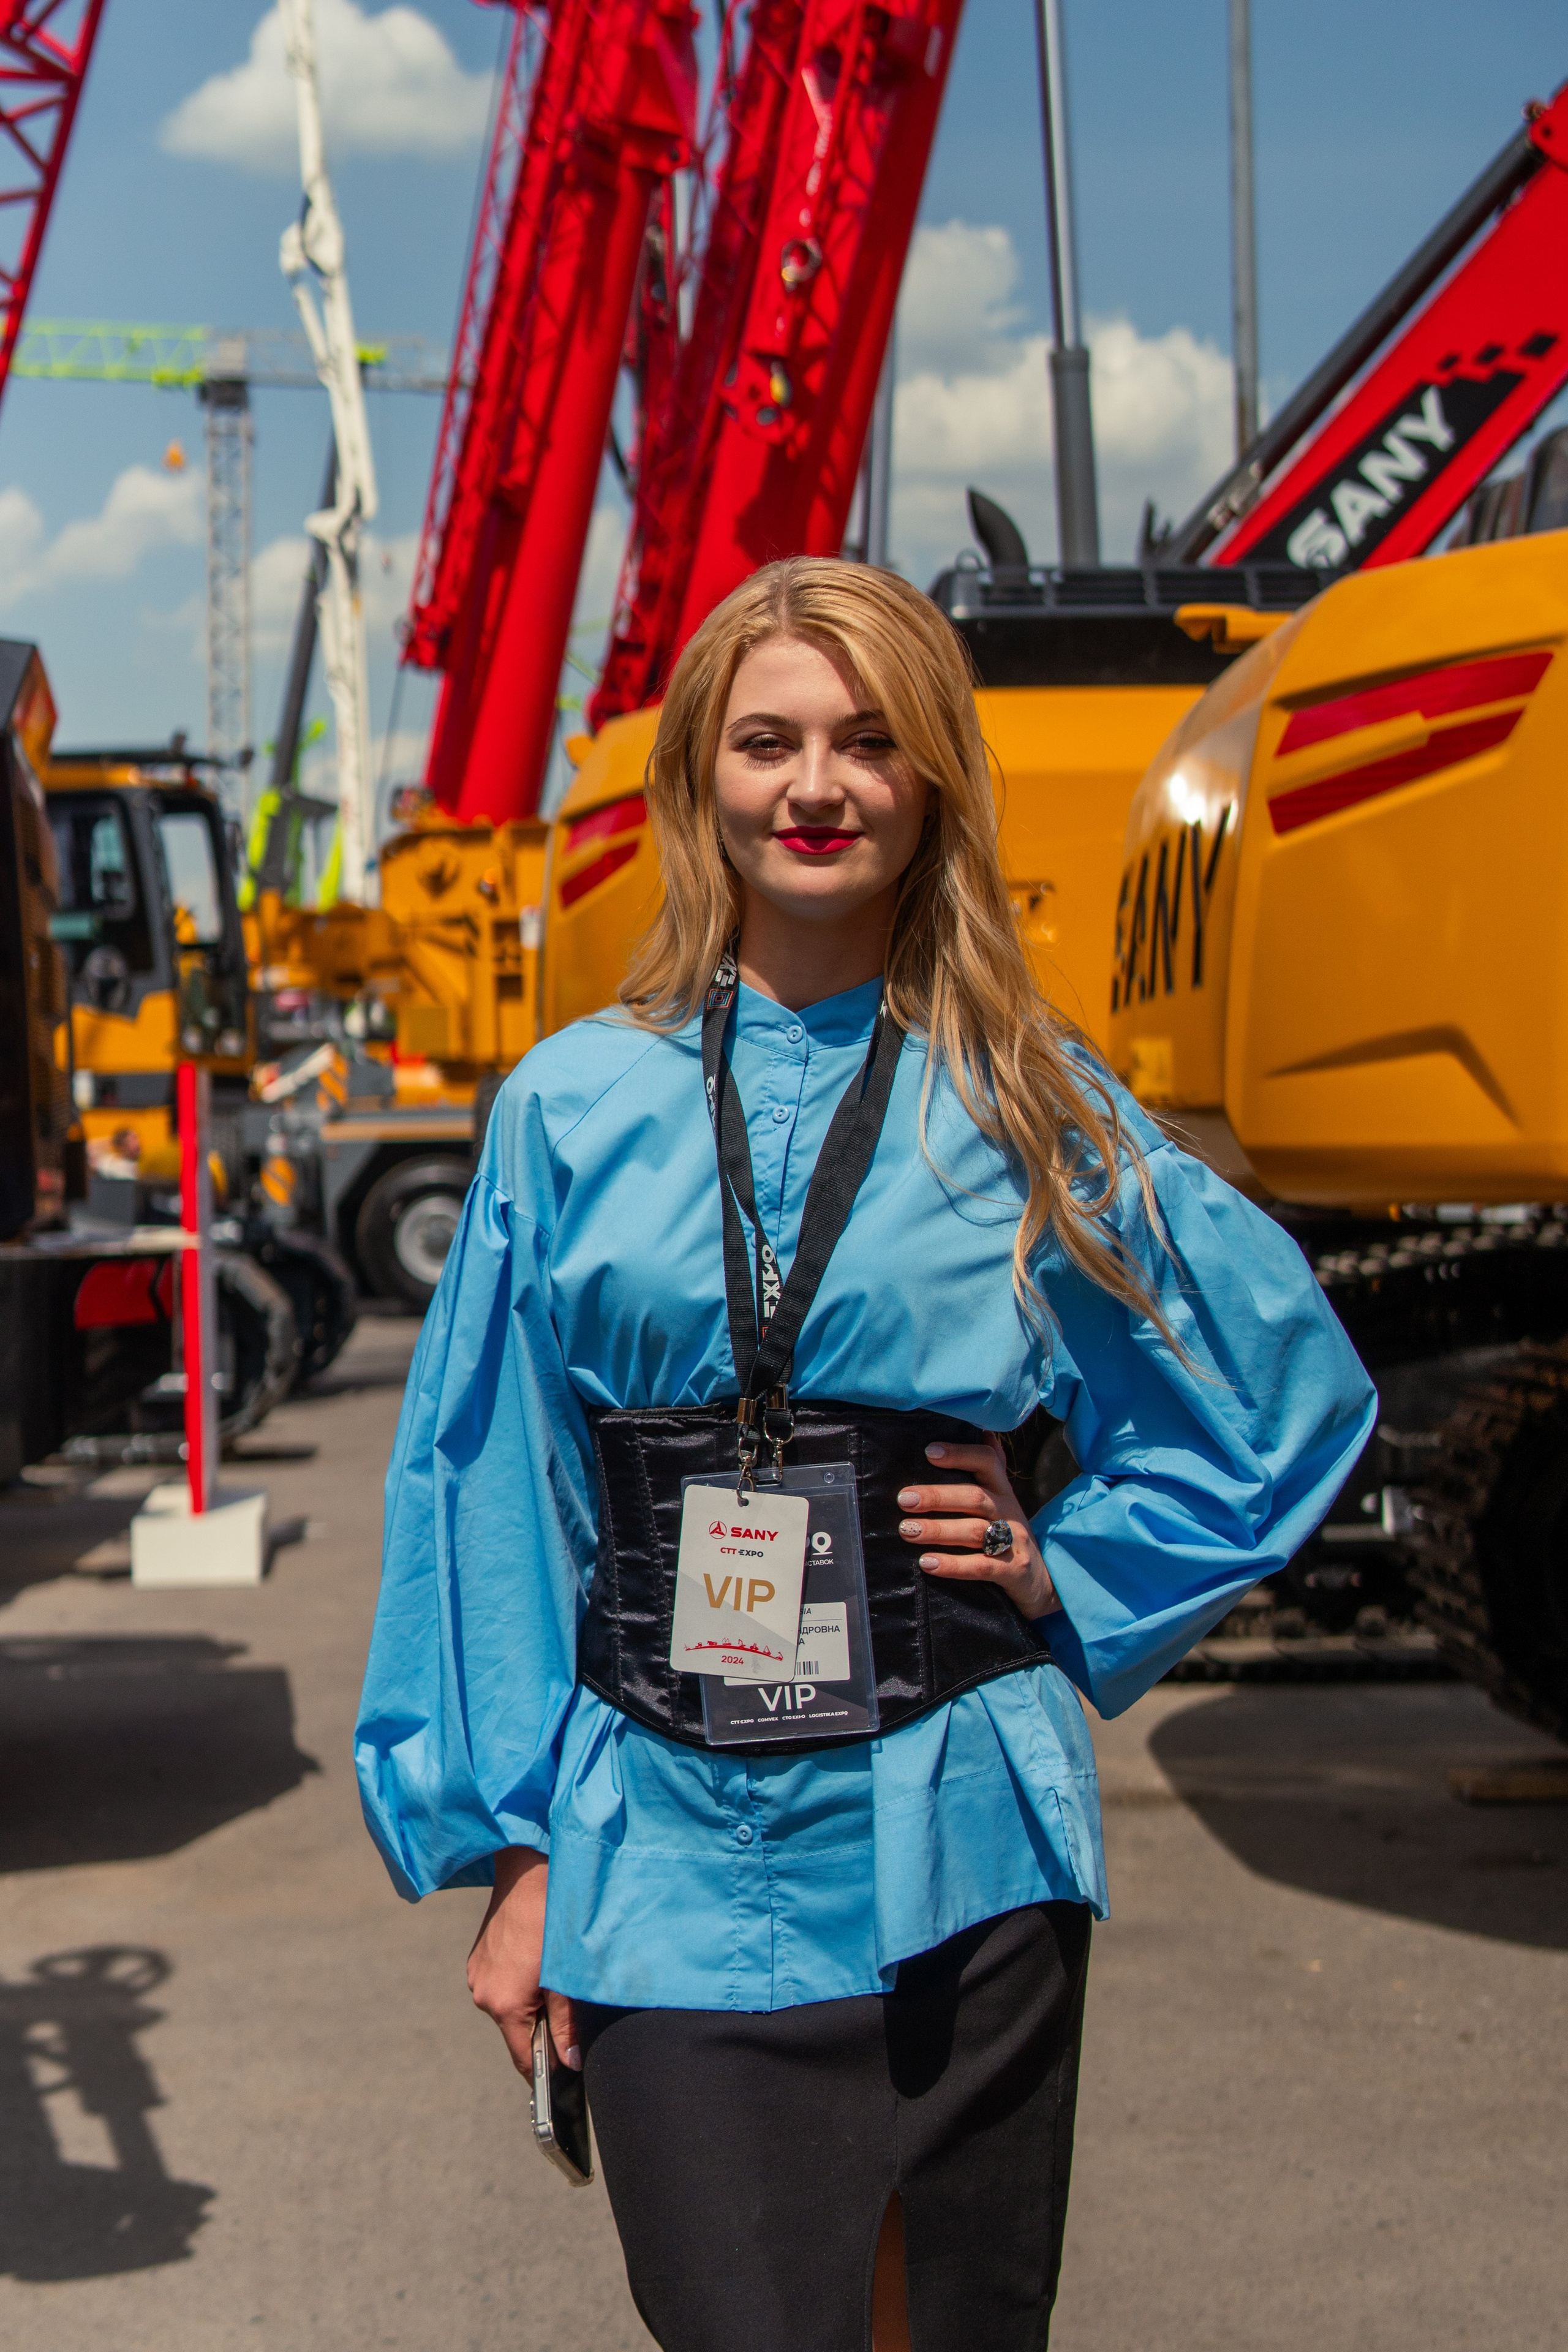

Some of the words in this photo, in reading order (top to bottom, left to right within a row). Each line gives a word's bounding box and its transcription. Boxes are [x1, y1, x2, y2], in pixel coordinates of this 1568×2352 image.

[1287, 385, 1455, 568] SANY
[731, 1526, 778, 1542] SANY
[720, 1547, 737, 1555] CTT
[738, 1549, 764, 1558] EXPO
[703, 1572, 775, 1613] VIP
[721, 1655, 744, 1665] 2024
[757, 1684, 816, 1712] VIP
